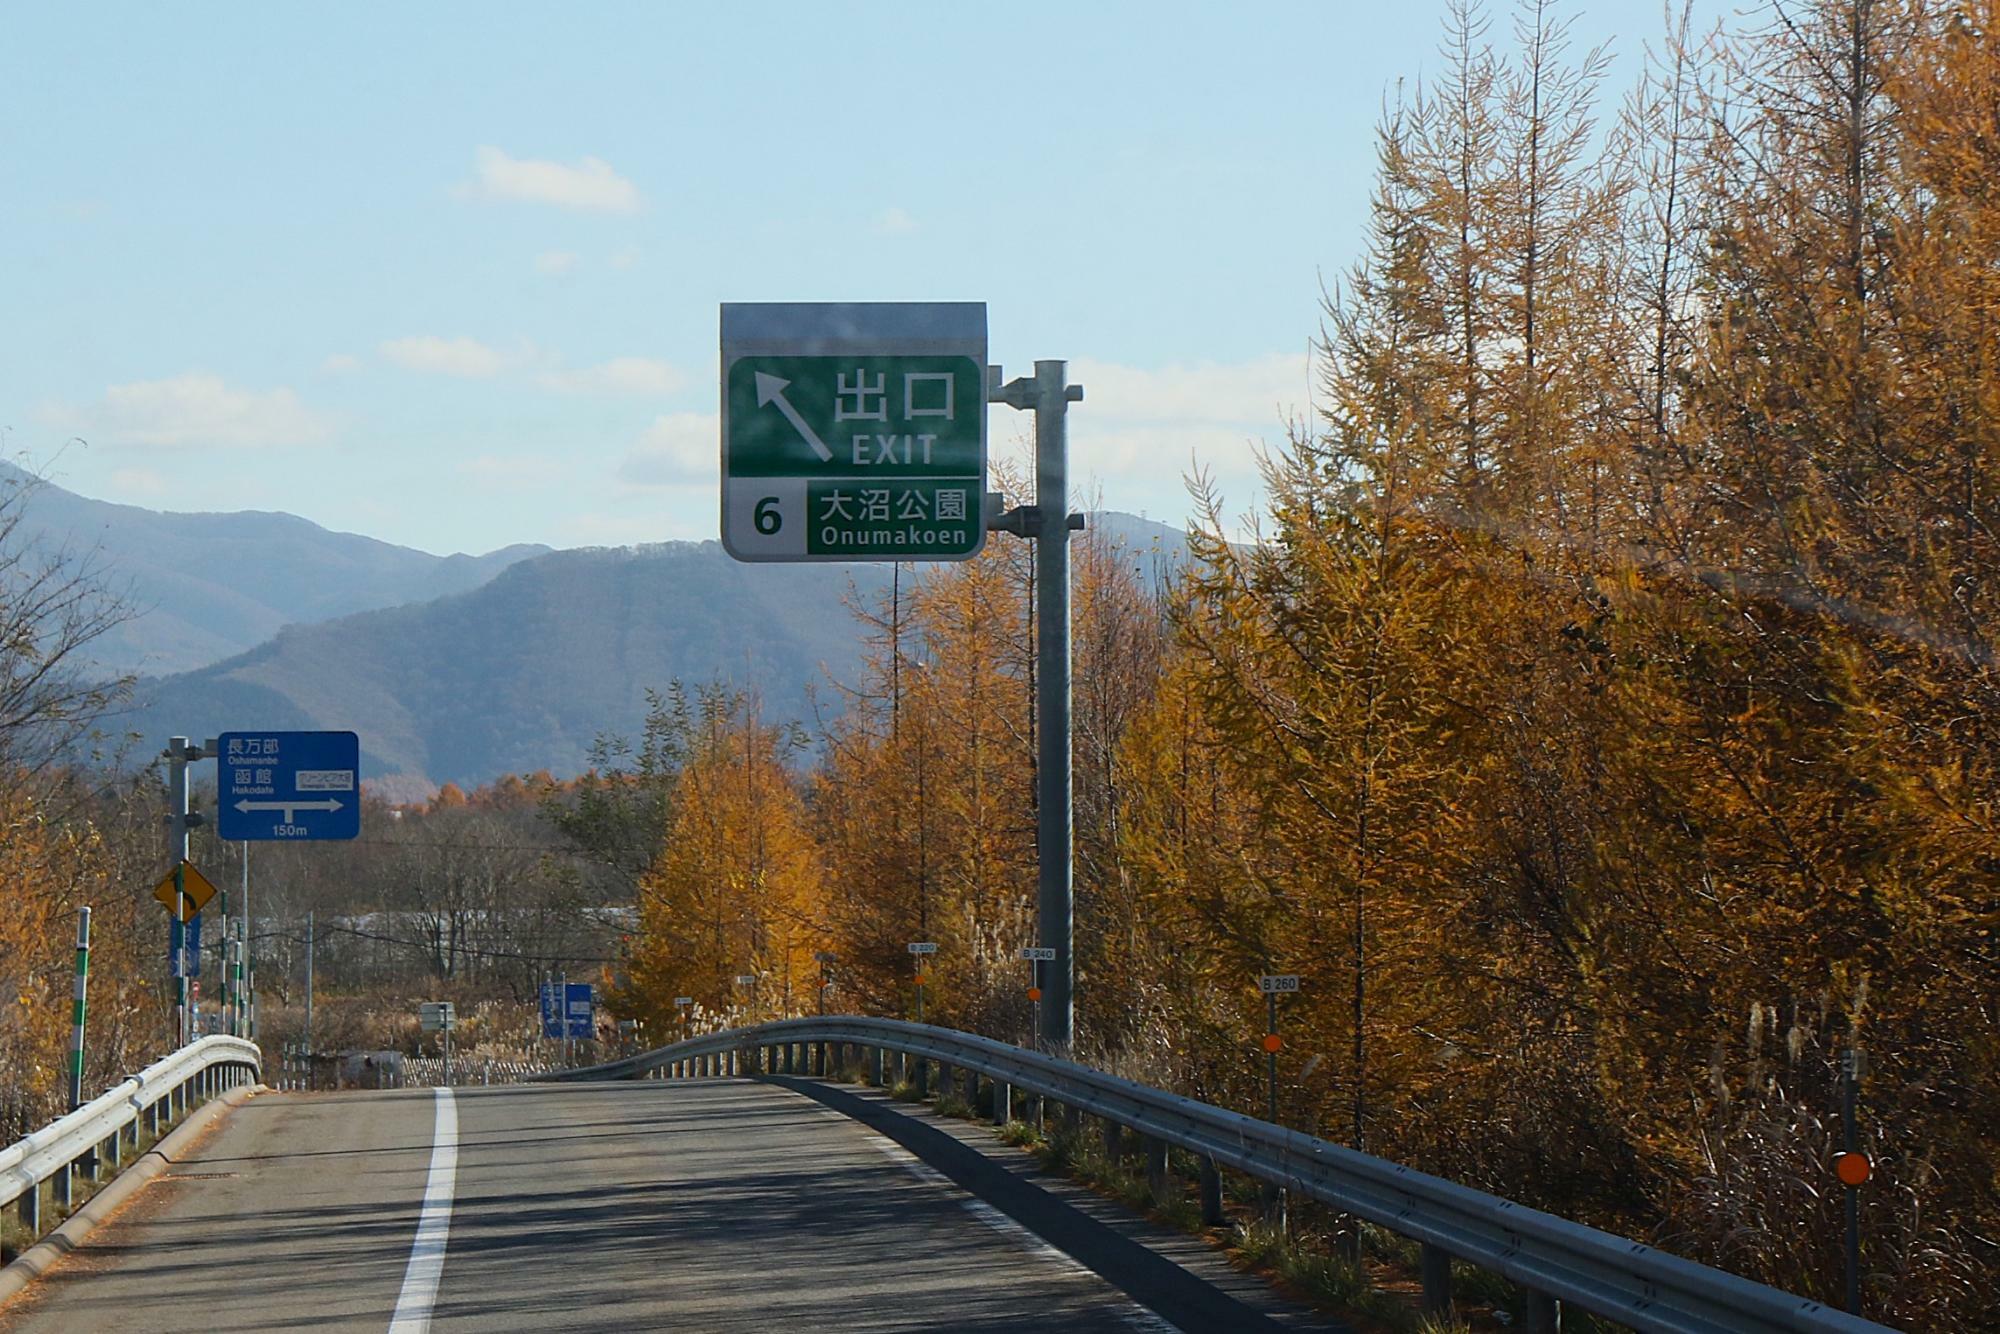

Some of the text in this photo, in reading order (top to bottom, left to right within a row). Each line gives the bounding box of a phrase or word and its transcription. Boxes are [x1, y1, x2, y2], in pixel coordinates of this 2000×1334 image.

[835, 369, 954, 422] 出口
[853, 435, 937, 464] EXIT
[820, 489, 967, 521] 大沼公園
[754, 497, 782, 535] 6
[822, 526, 966, 545] Onumakoen
[228, 739, 279, 754] 長万部
[228, 756, 278, 765] Oshamanbe
[235, 769, 272, 784] 函館
[232, 786, 274, 794] Hakodate
[272, 825, 307, 836] 150m
[1023, 949, 1052, 958] B 240
[1263, 978, 1296, 989] B 260
